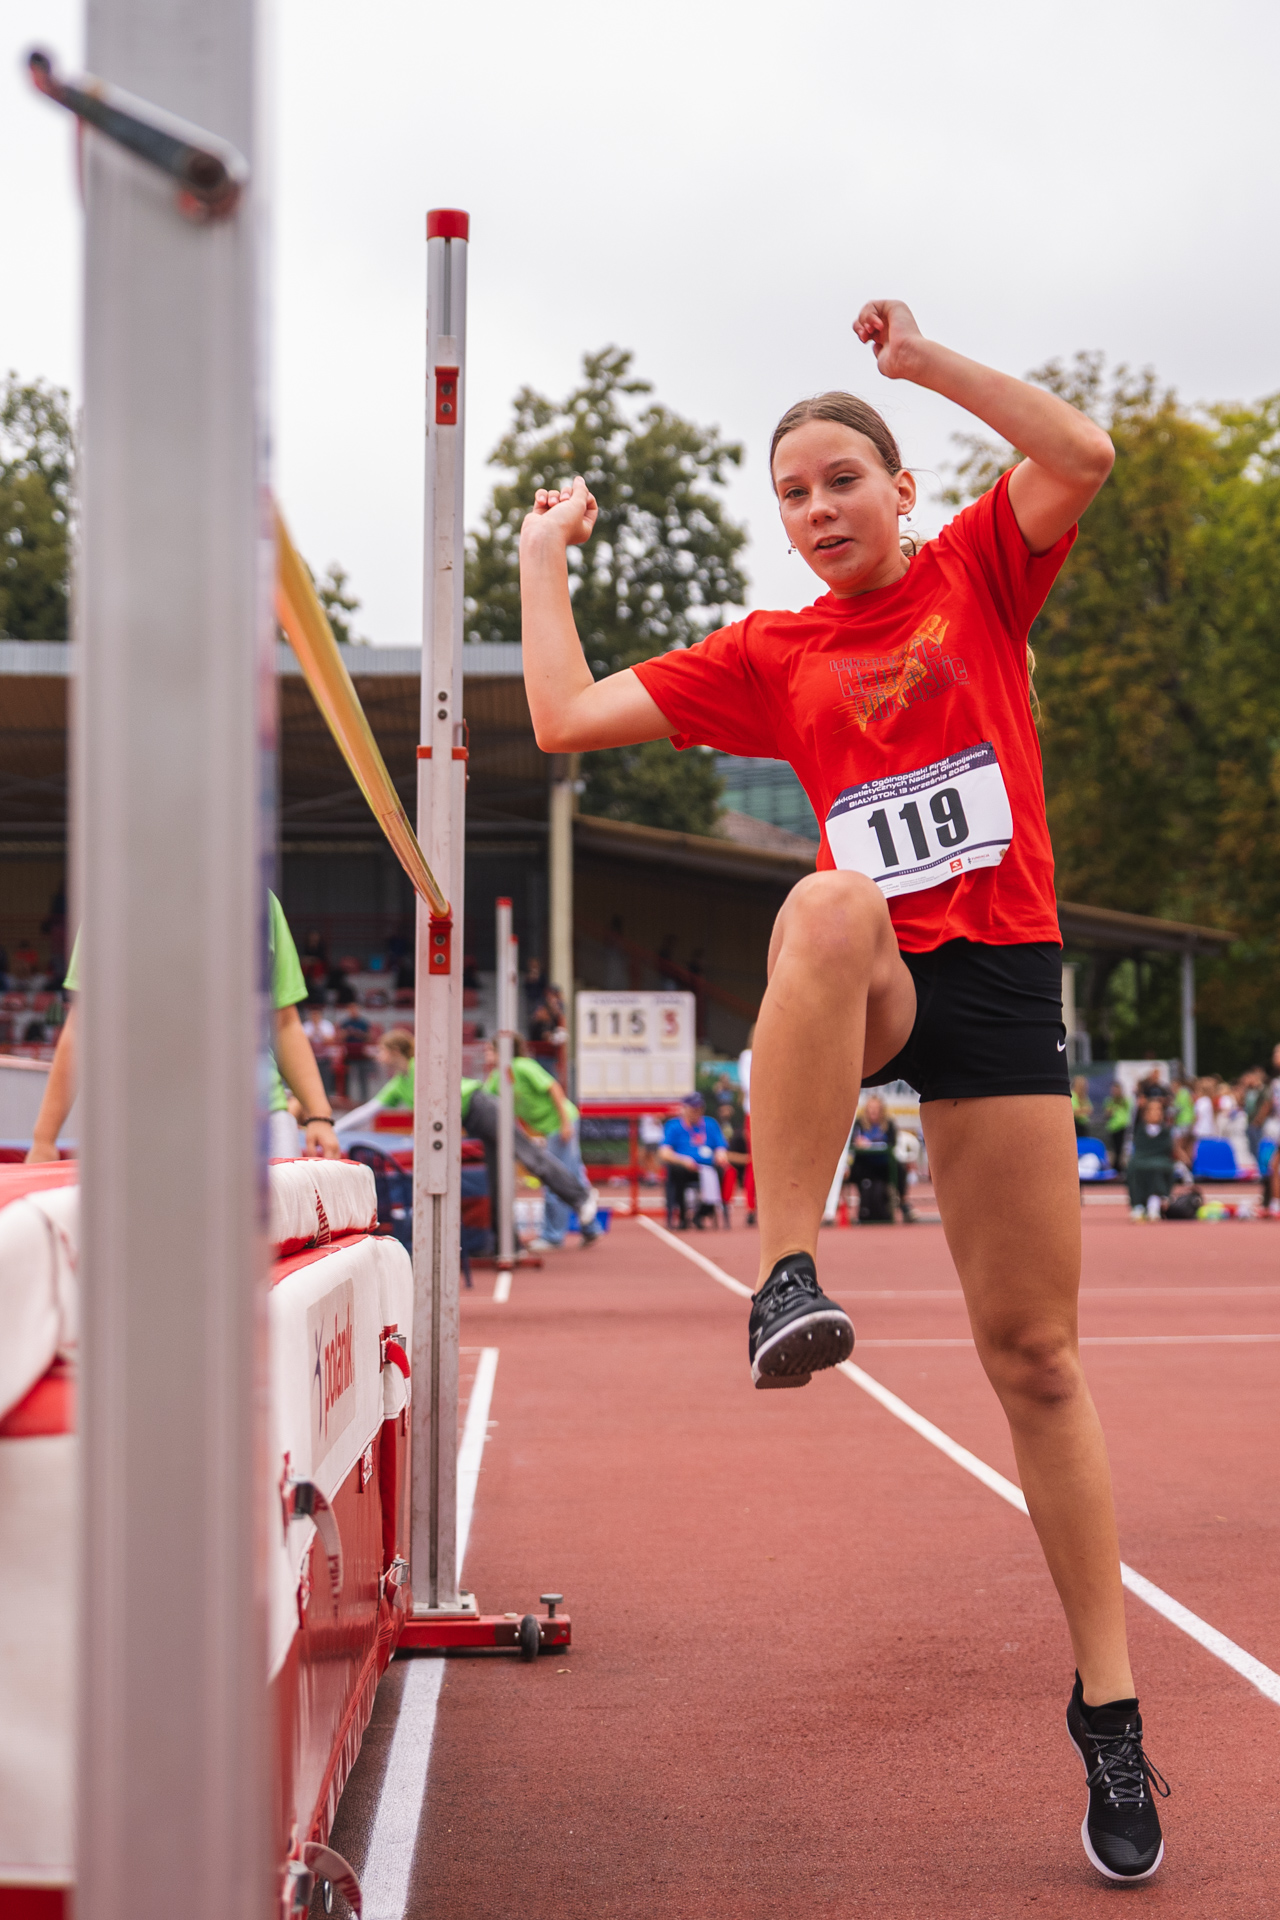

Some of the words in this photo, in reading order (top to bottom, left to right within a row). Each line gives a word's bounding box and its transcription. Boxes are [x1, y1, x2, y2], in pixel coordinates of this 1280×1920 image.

[848, 790, 898, 808] BIAŁYSTOK,
[909, 773, 948, 792] września
[948, 763, 970, 777] 2025
[871, 766, 928, 788] Ogólnopolski
[929, 757, 950, 771] Finał
[908, 769, 939, 785] Nadziei
[940, 749, 988, 773] Olimpijskich
[867, 787, 969, 868] 119
